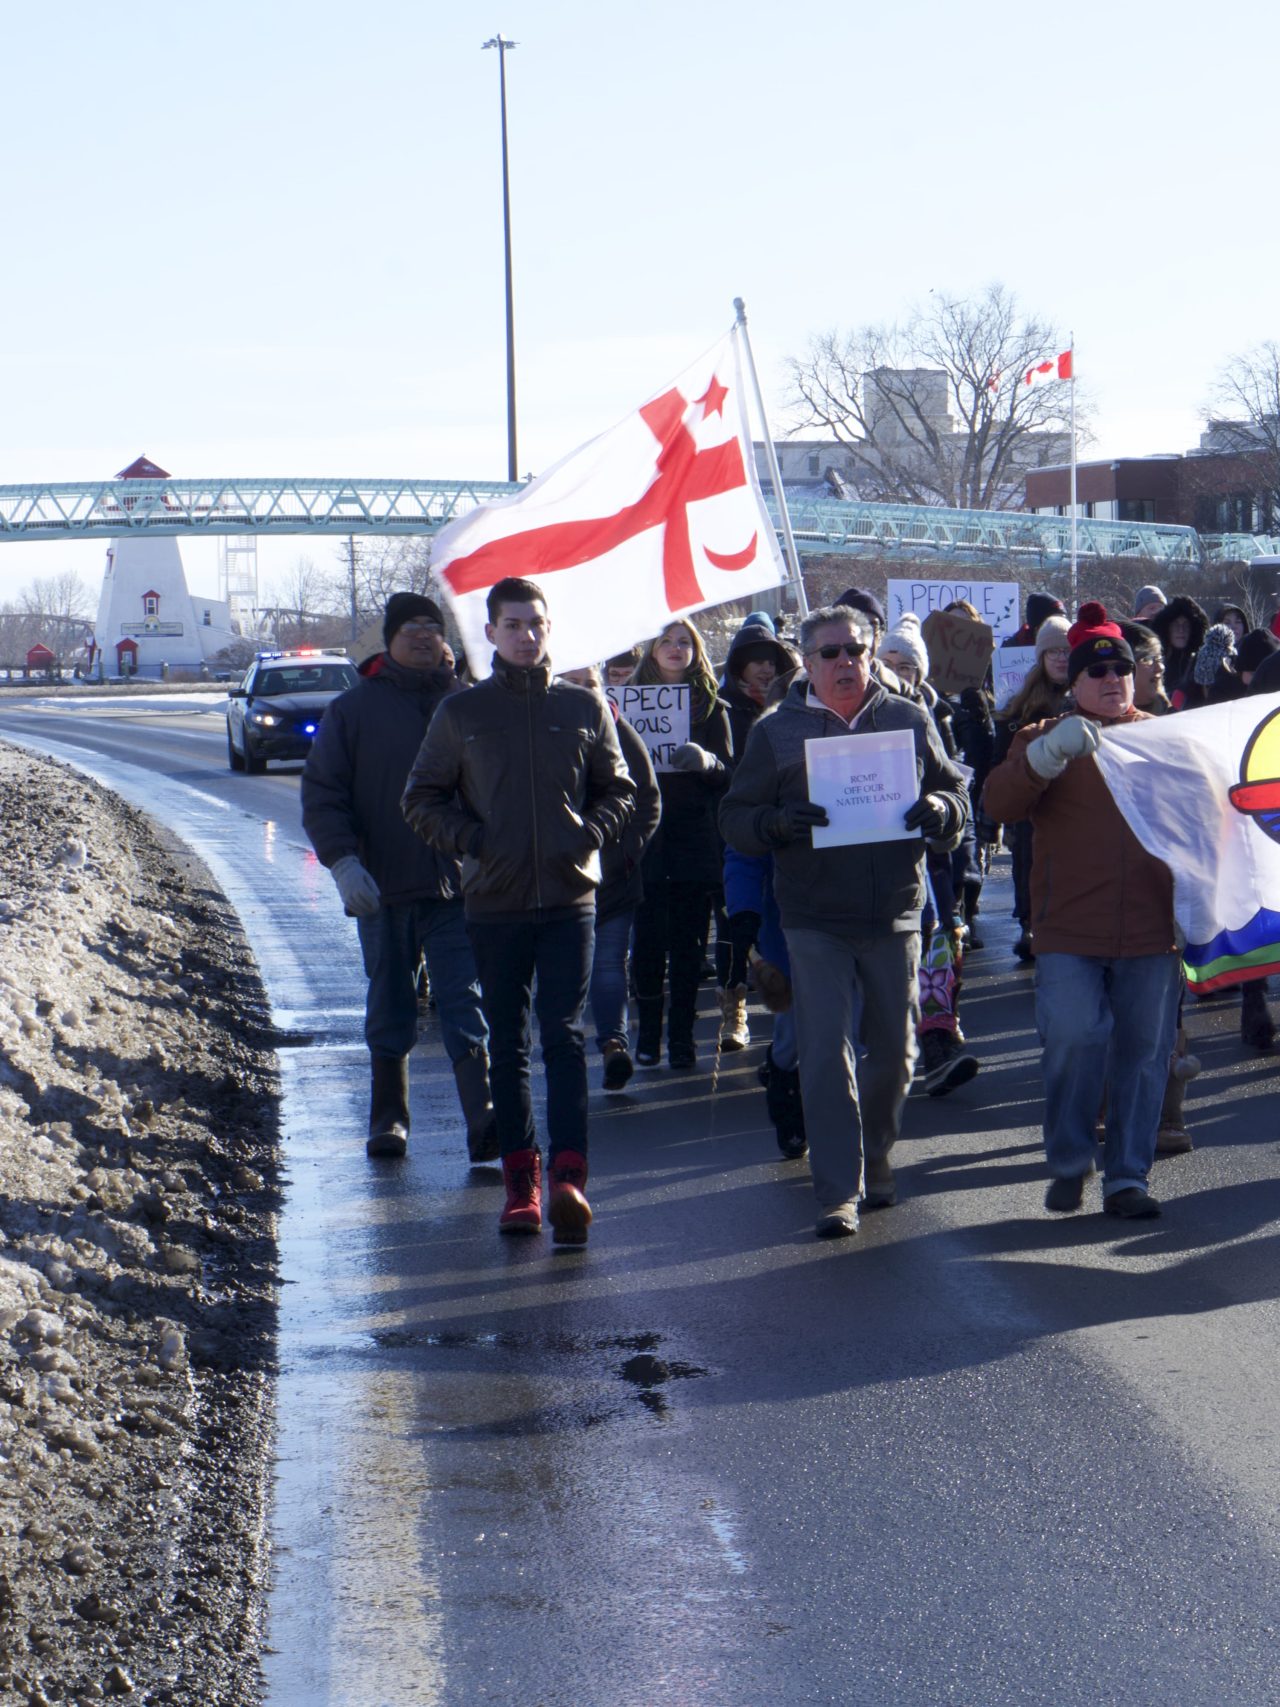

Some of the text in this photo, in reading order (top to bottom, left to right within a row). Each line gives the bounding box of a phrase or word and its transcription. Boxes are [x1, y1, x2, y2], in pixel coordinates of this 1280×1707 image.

[606, 686, 688, 712] SPECT
[850, 773, 878, 784] RCMP
[844, 783, 884, 795] OFF OUR
[836, 792, 902, 807] NATIVE LAND
